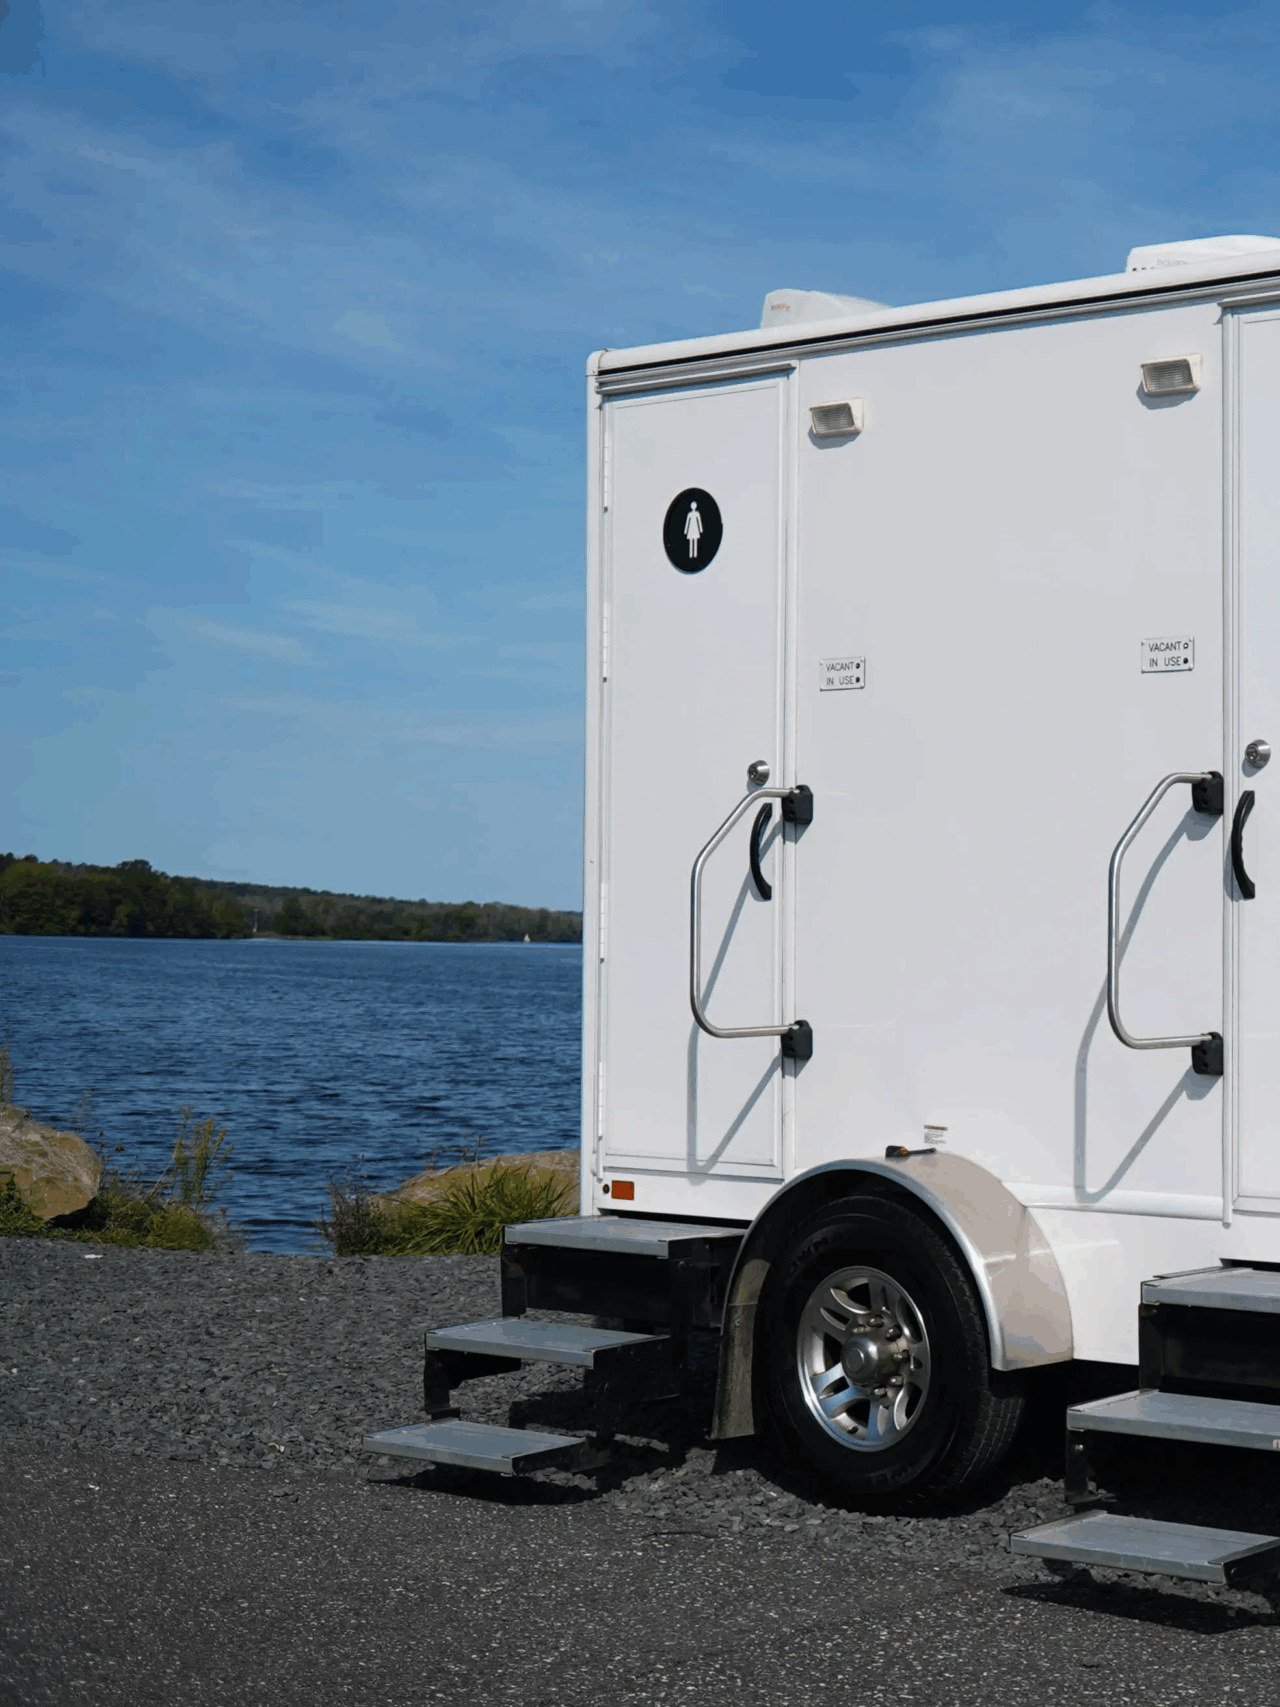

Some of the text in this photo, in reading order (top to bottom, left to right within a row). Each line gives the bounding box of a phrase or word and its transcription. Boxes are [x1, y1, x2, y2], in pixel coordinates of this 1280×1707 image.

[1148, 641, 1182, 652] VACANT
[826, 661, 854, 671] VACANT
[1149, 656, 1181, 667] IN USE
[826, 675, 854, 686] IN USE
